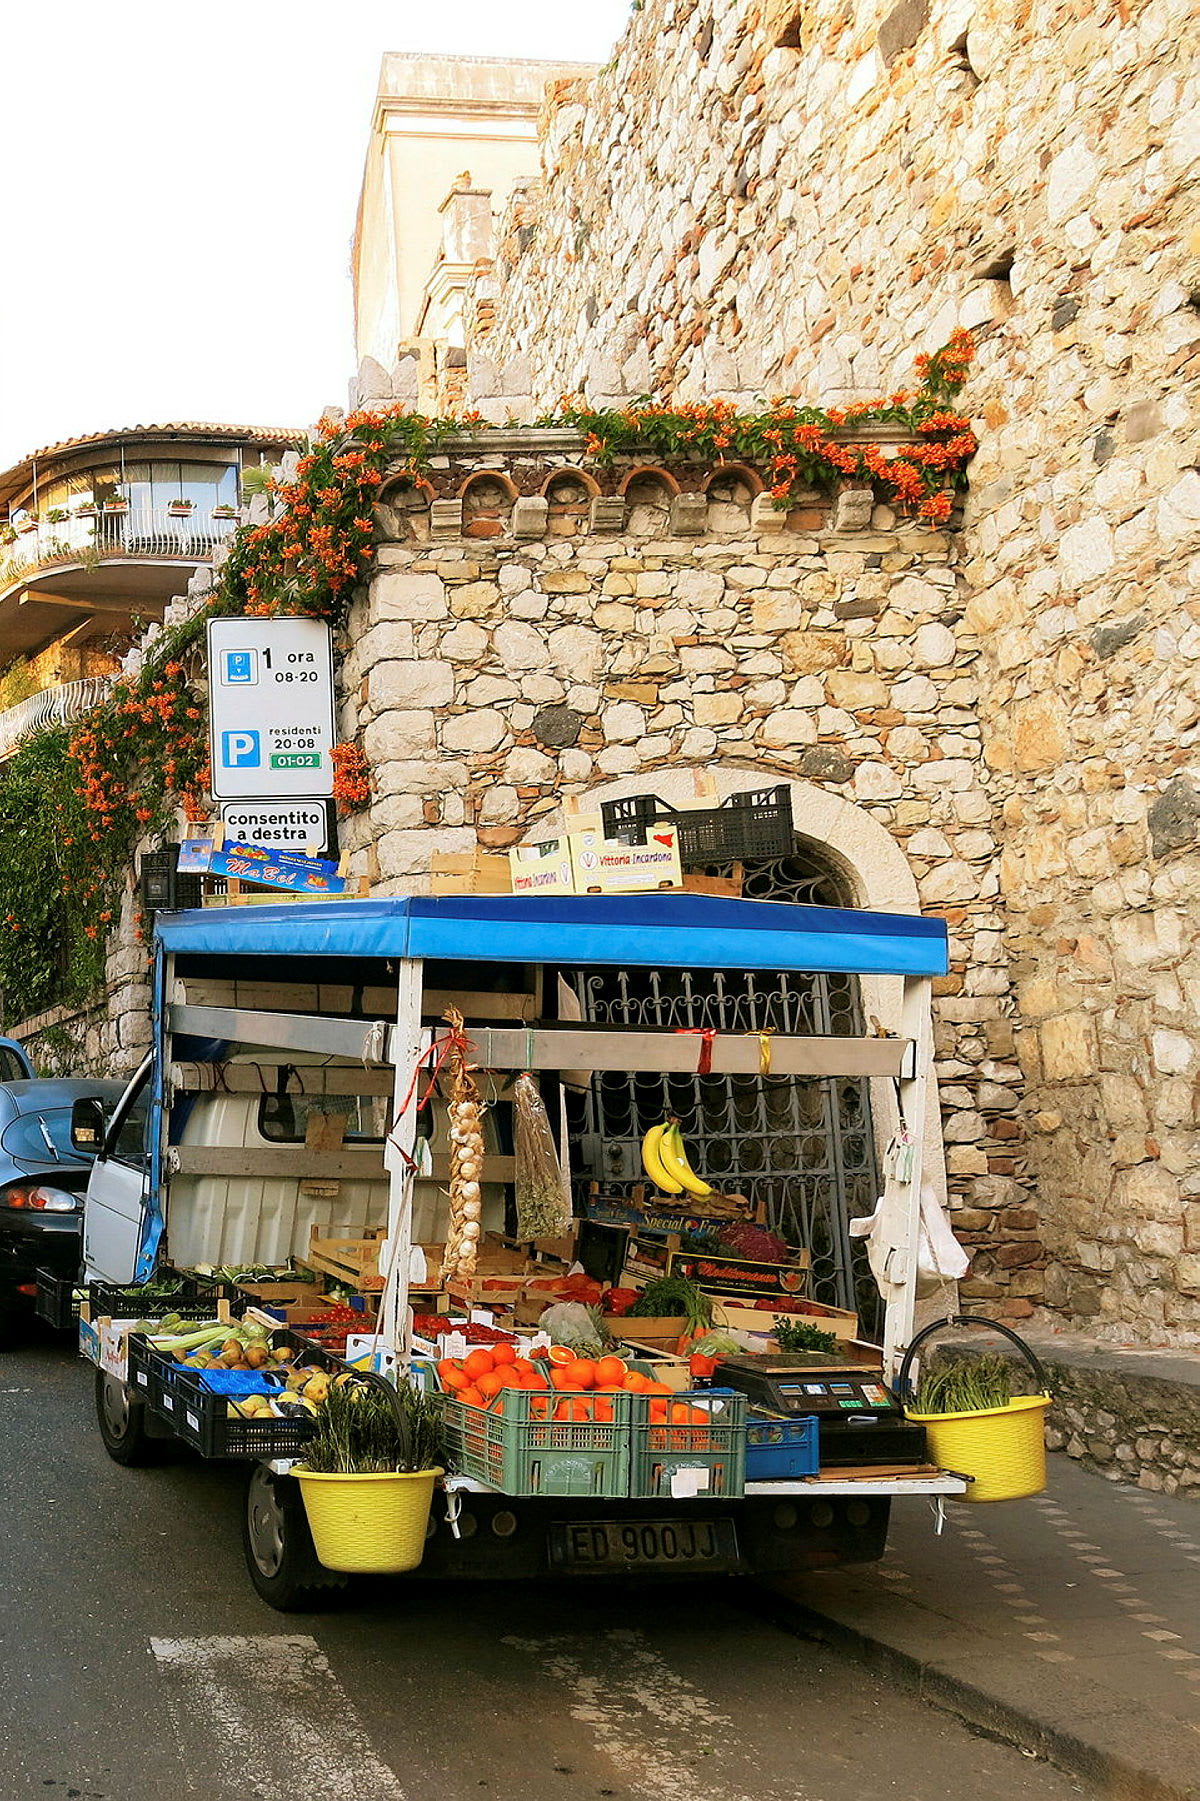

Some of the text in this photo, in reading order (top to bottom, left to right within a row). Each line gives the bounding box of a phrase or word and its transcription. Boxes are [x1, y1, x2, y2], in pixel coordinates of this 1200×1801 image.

[262, 647, 315, 669] 1 ora
[275, 671, 318, 683] 08-20
[269, 726, 321, 735] residenti
[228, 733, 255, 765] P
[274, 738, 315, 749] 20-08
[277, 756, 314, 766] 01-02
[228, 811, 320, 825] consentito
[237, 827, 307, 840] a destra
[600, 852, 673, 867] Vittoria Incardona
[644, 1211, 684, 1231] Special
[571, 1525, 715, 1562] ED 900JJ
